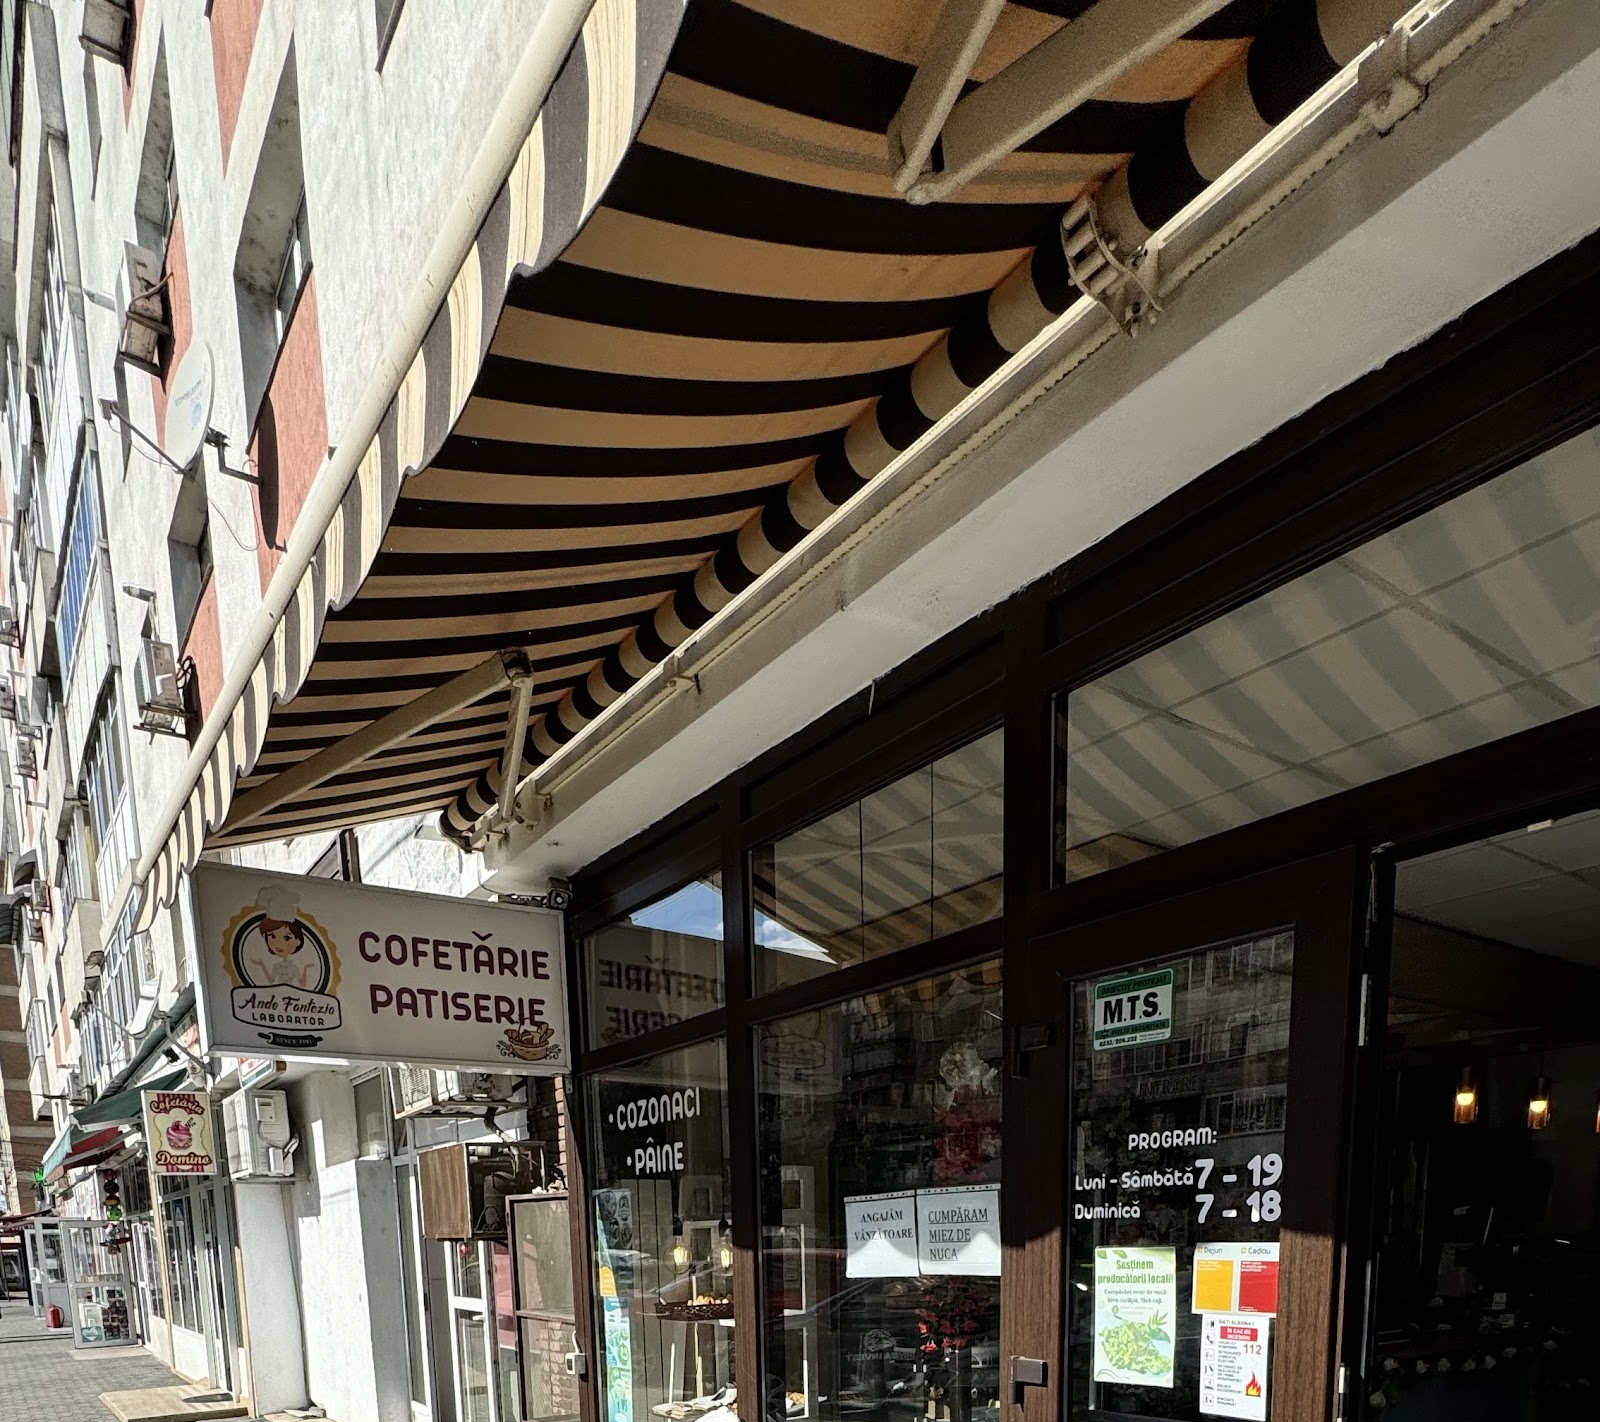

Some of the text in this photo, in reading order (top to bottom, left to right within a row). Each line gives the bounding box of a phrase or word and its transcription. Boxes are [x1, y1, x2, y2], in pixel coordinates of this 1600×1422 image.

[358, 931, 550, 980] COFETĂRIE
[370, 983, 545, 1026] PATISERIE
[1103, 992, 1162, 1025] M.T.S.
[252, 1012, 325, 1026] LABORATOR
[616, 1086, 701, 1131] COZONACI
[1128, 1127, 1217, 1151] PROGRAM:
[156, 1151, 211, 1165] Domino
[634, 1136, 685, 1176] PÂINE
[1075, 1173, 1106, 1190] Luni
[1121, 1166, 1194, 1189] Sâmbătă
[1195, 1158, 1215, 1190] 7
[1247, 1153, 1283, 1187] 19
[928, 1206, 988, 1223] CUMPĂRAM
[1074, 1200, 1141, 1220] Duminică
[1195, 1193, 1215, 1224] 7
[1246, 1189, 1282, 1223] 18
[929, 1228, 971, 1242] MIEZ DE
[929, 1248, 958, 1260] NUCA
[1204, 1246, 1223, 1256] Dejun
[1248, 1247, 1271, 1255] Cadou
[1243, 1343, 1262, 1355] 112
